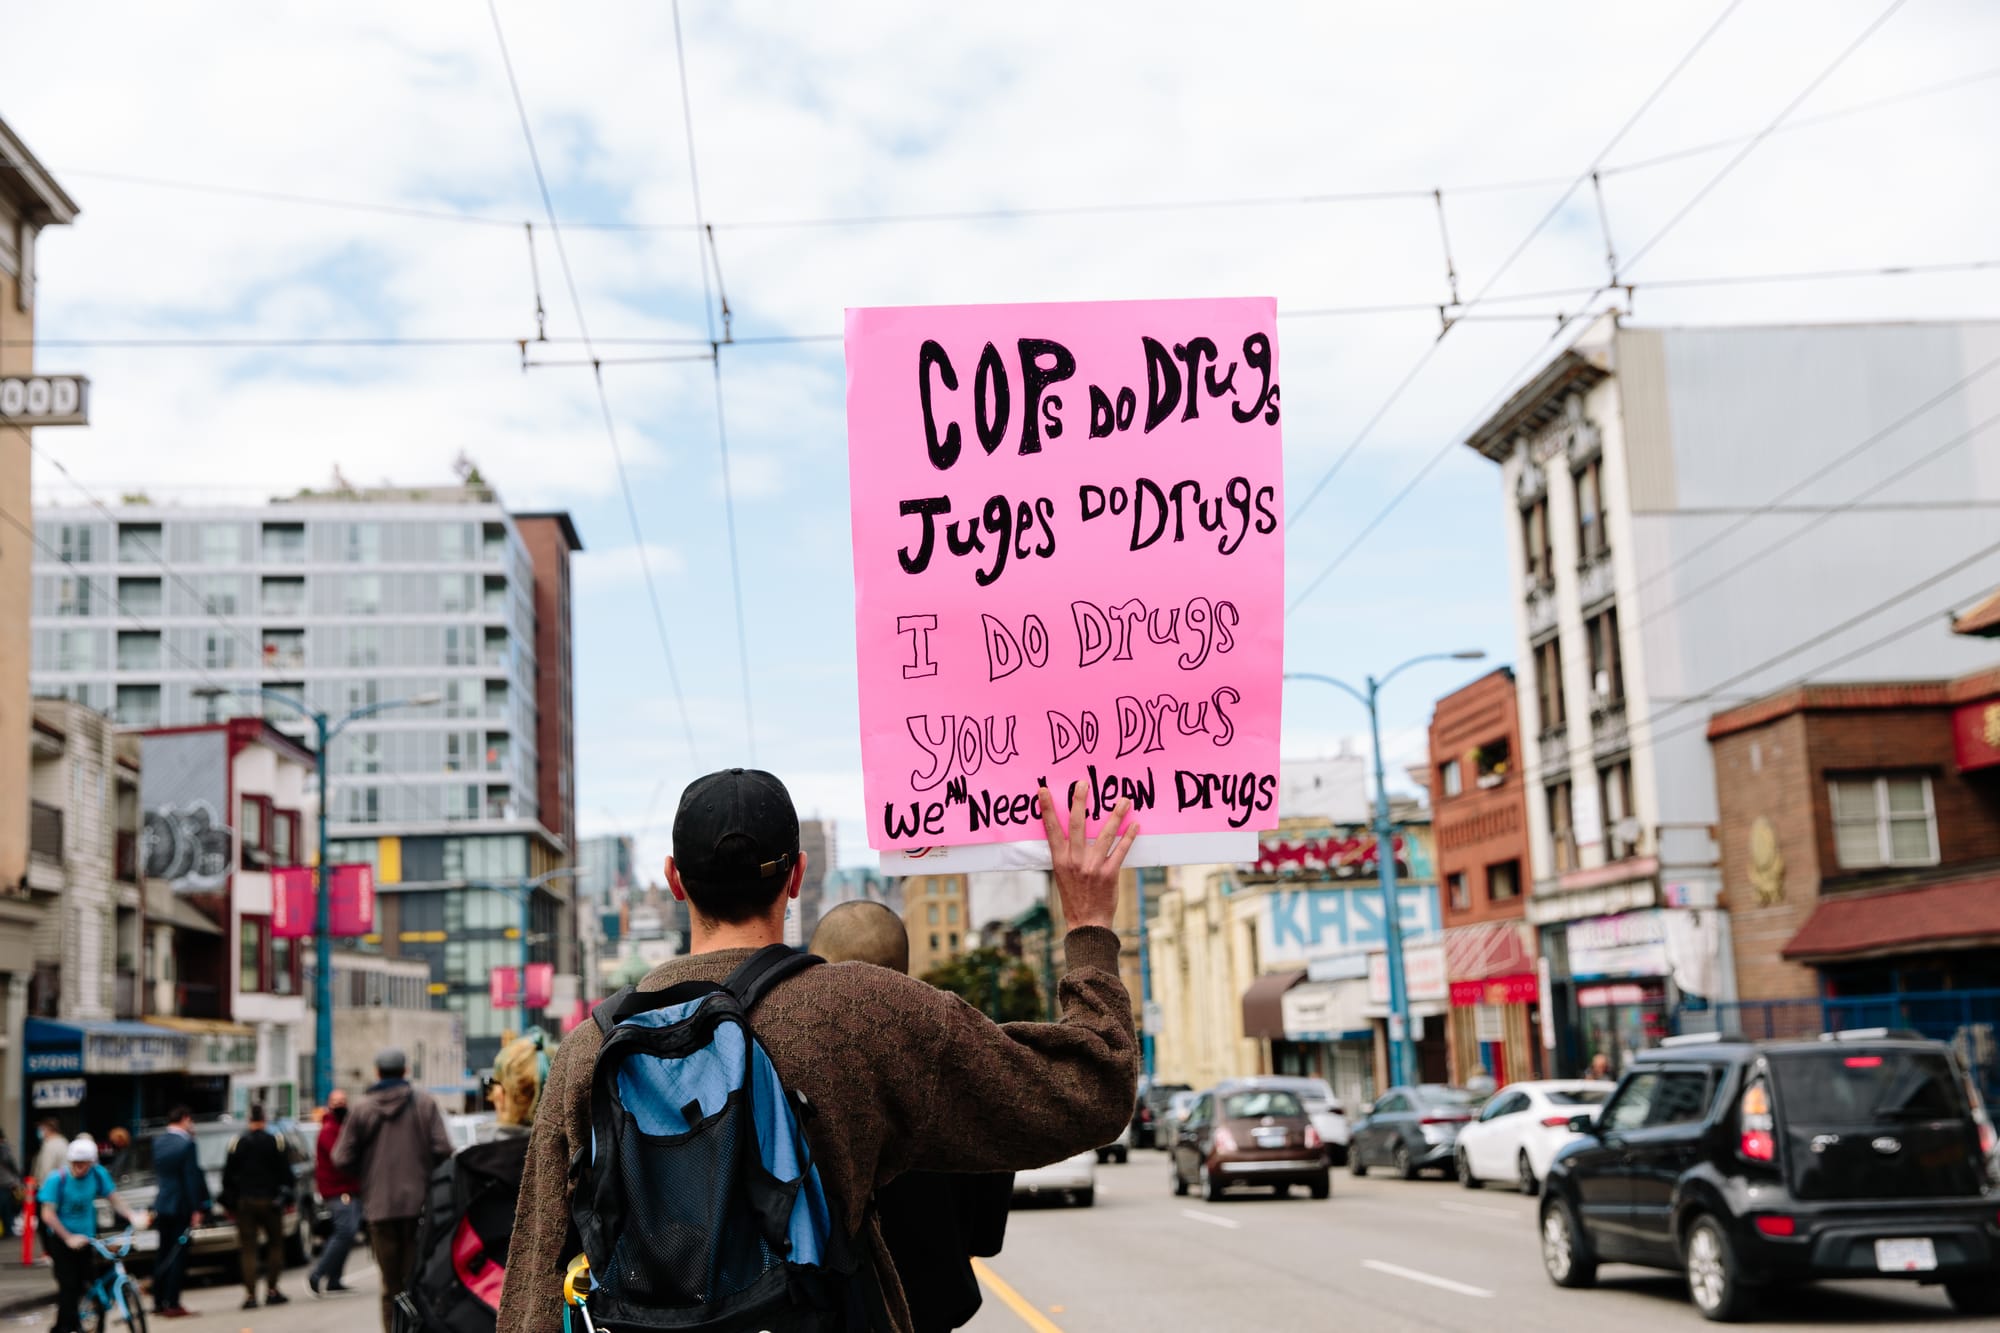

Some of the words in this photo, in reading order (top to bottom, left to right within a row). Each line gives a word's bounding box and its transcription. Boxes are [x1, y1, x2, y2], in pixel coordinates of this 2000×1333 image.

[1141, 331, 1281, 435] Drugs
[897, 494, 1056, 586] Juges
[1129, 476, 1278, 556] Drugs
[896, 614, 938, 680] I
[1070, 596, 1240, 671] Drugs
[1115, 685, 1241, 760] Drus
[1174, 769, 1277, 829] Drugs
